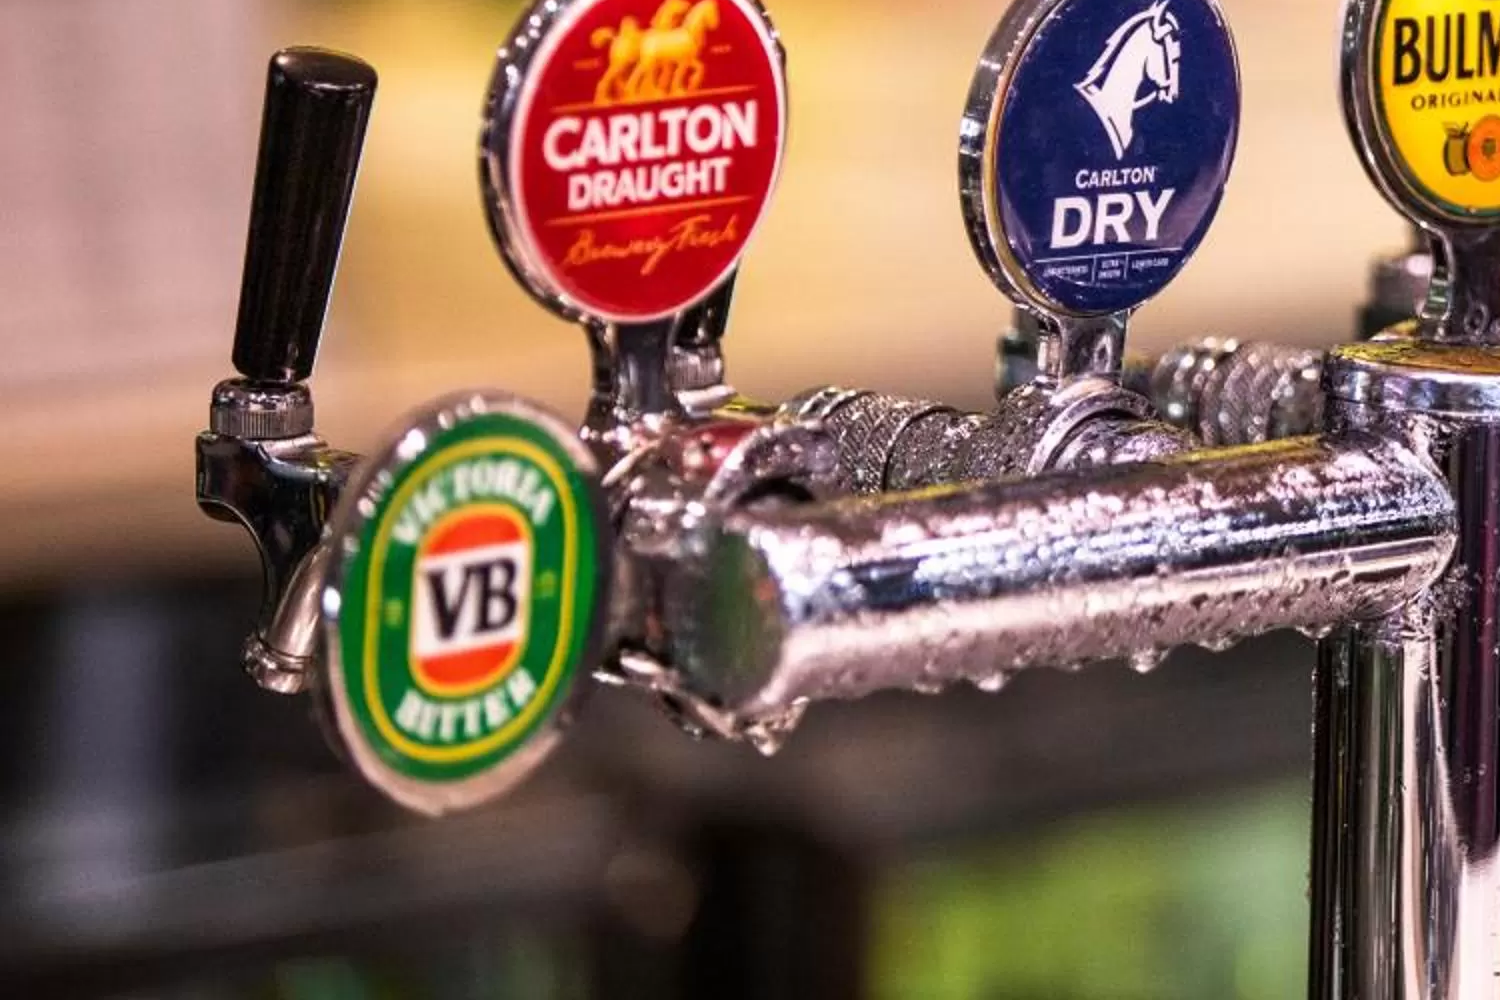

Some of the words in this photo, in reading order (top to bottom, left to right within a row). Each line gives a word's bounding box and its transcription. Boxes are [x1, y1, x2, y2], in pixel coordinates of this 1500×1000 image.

[543, 99, 759, 171] CARLTON
[567, 157, 731, 212] DRAUGHT
[1075, 166, 1156, 189] CARLTON
[1050, 188, 1176, 249] DRY
[391, 457, 555, 545] VICTORIA
[425, 557, 518, 642] VB
[394, 665, 537, 741] BITTER
